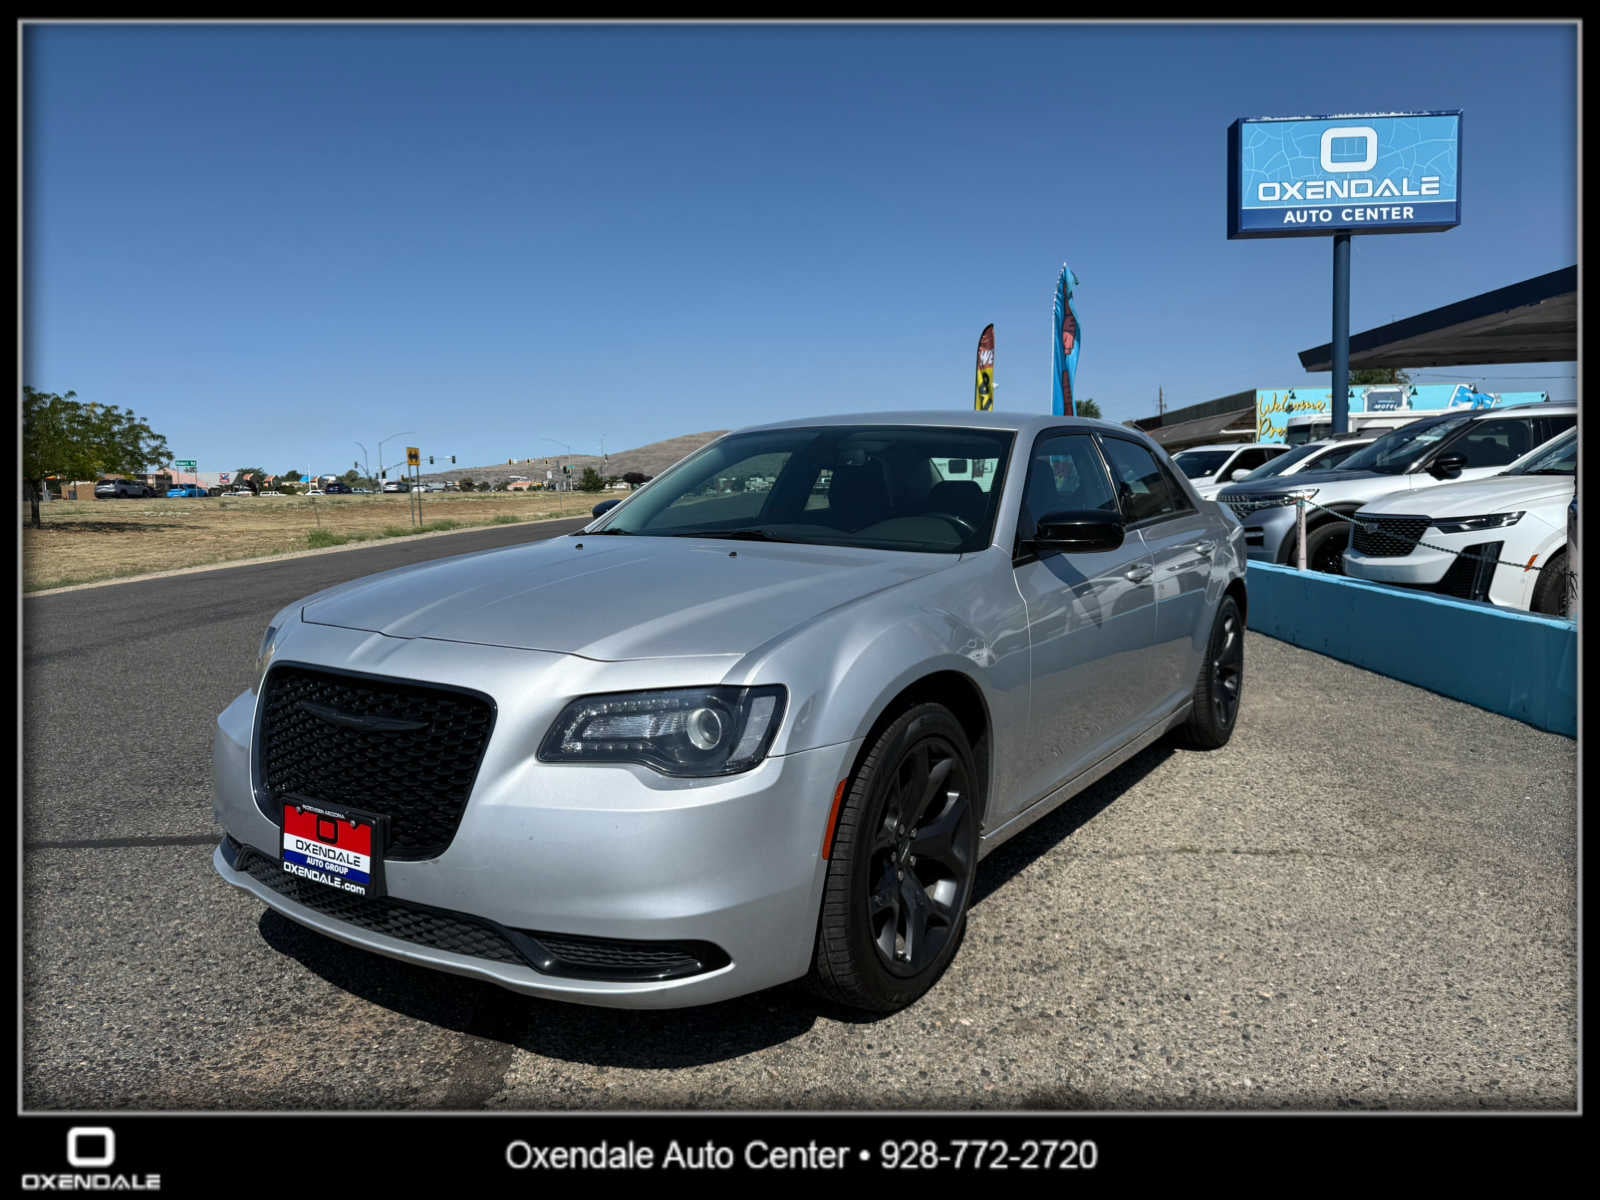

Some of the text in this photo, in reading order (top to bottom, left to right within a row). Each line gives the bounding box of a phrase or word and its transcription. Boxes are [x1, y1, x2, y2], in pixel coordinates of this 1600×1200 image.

[1258, 176, 1440, 201] OXENDALE
[1283, 206, 1414, 223] AUTO CENTER
[1258, 392, 1325, 416] Welcome
[296, 839, 360, 867] OXENDALE
[306, 856, 348, 874] AUTO GROUP
[283, 861, 365, 895] OXENDALE.com
